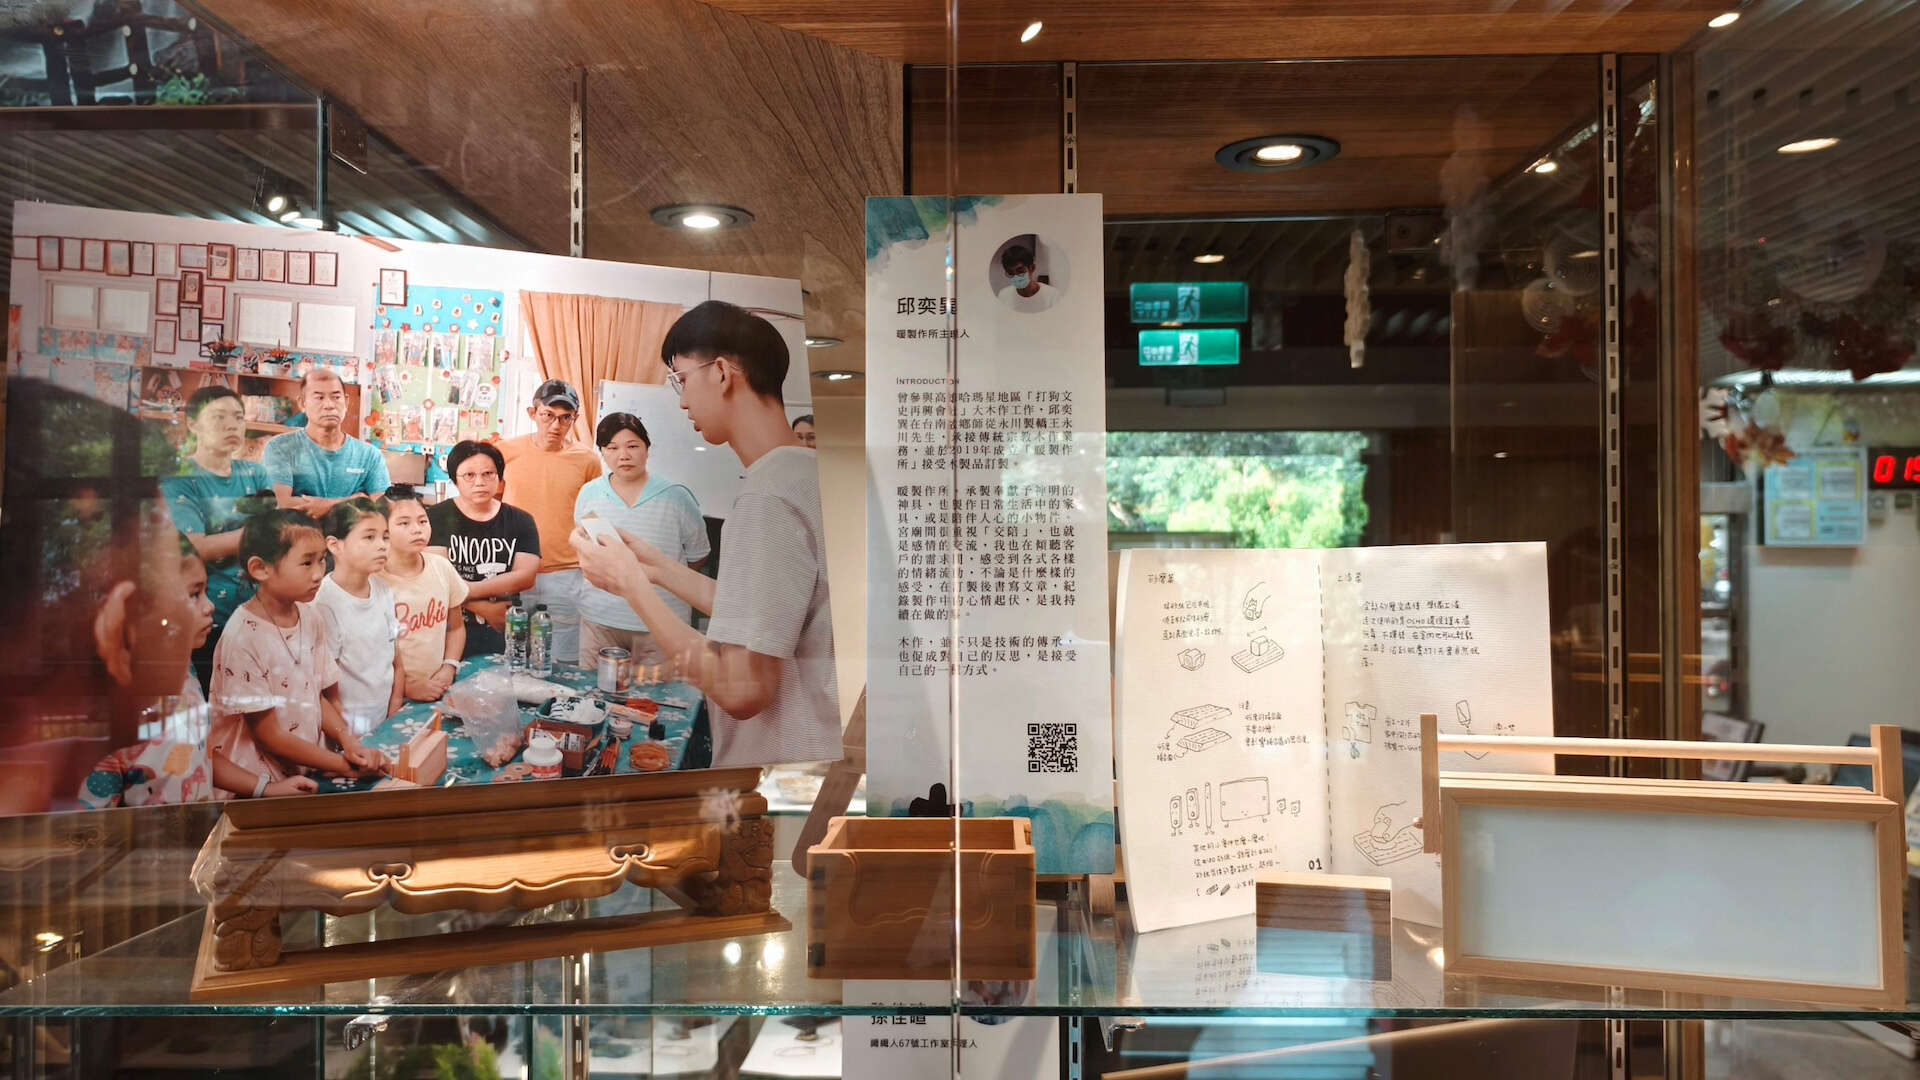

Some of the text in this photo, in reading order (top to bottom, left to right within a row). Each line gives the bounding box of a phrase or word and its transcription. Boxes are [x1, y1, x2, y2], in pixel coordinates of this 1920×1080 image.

[896, 376, 960, 385] INTRODUCTON
[897, 405, 1072, 417] 史再興會」大木作工作，邱奕
[448, 534, 517, 566] SNOOPY
[394, 597, 447, 639] Barbie
[1308, 857, 1323, 871] 01
